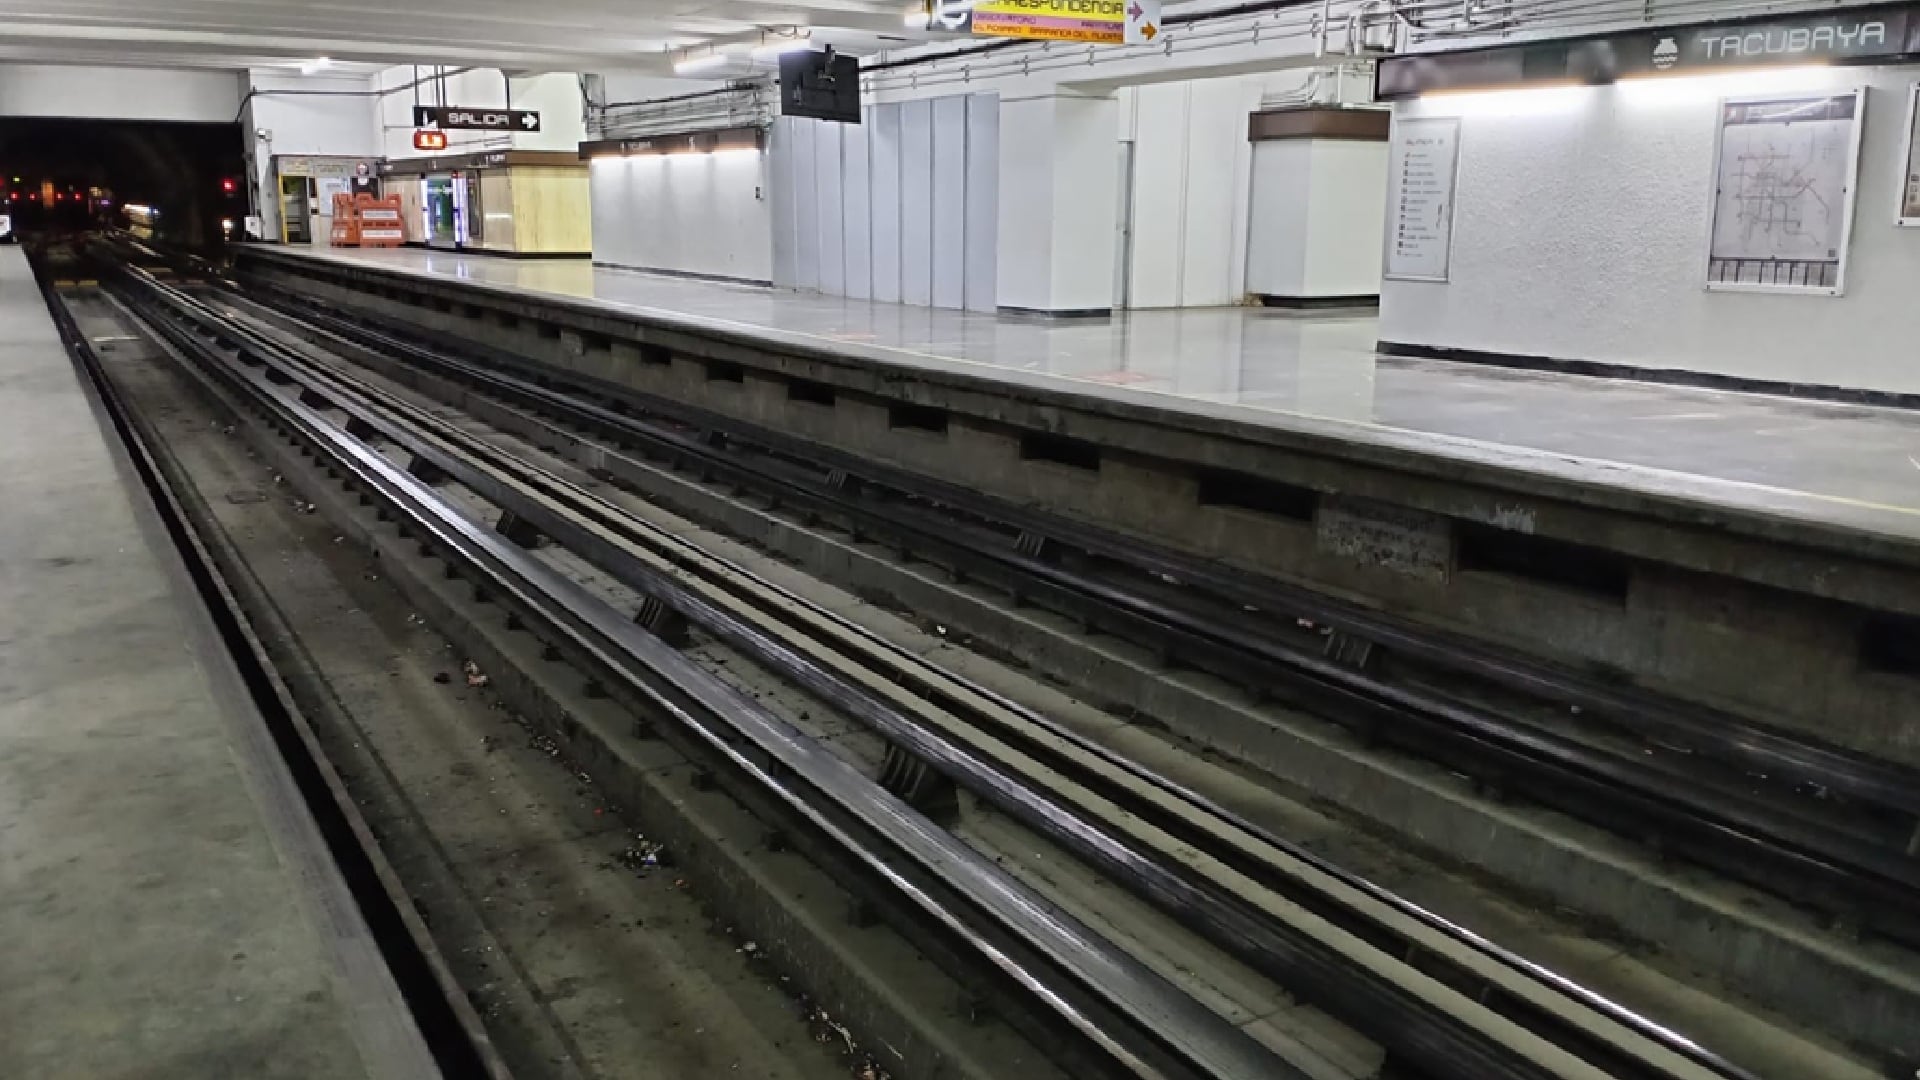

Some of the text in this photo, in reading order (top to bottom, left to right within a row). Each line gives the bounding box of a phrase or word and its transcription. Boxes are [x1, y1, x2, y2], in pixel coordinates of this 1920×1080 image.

[985, 0, 1124, 15] ESPONDENCIA
[1701, 22, 1885, 59] TACUBAYA
[448, 112, 509, 126] SALIDA
